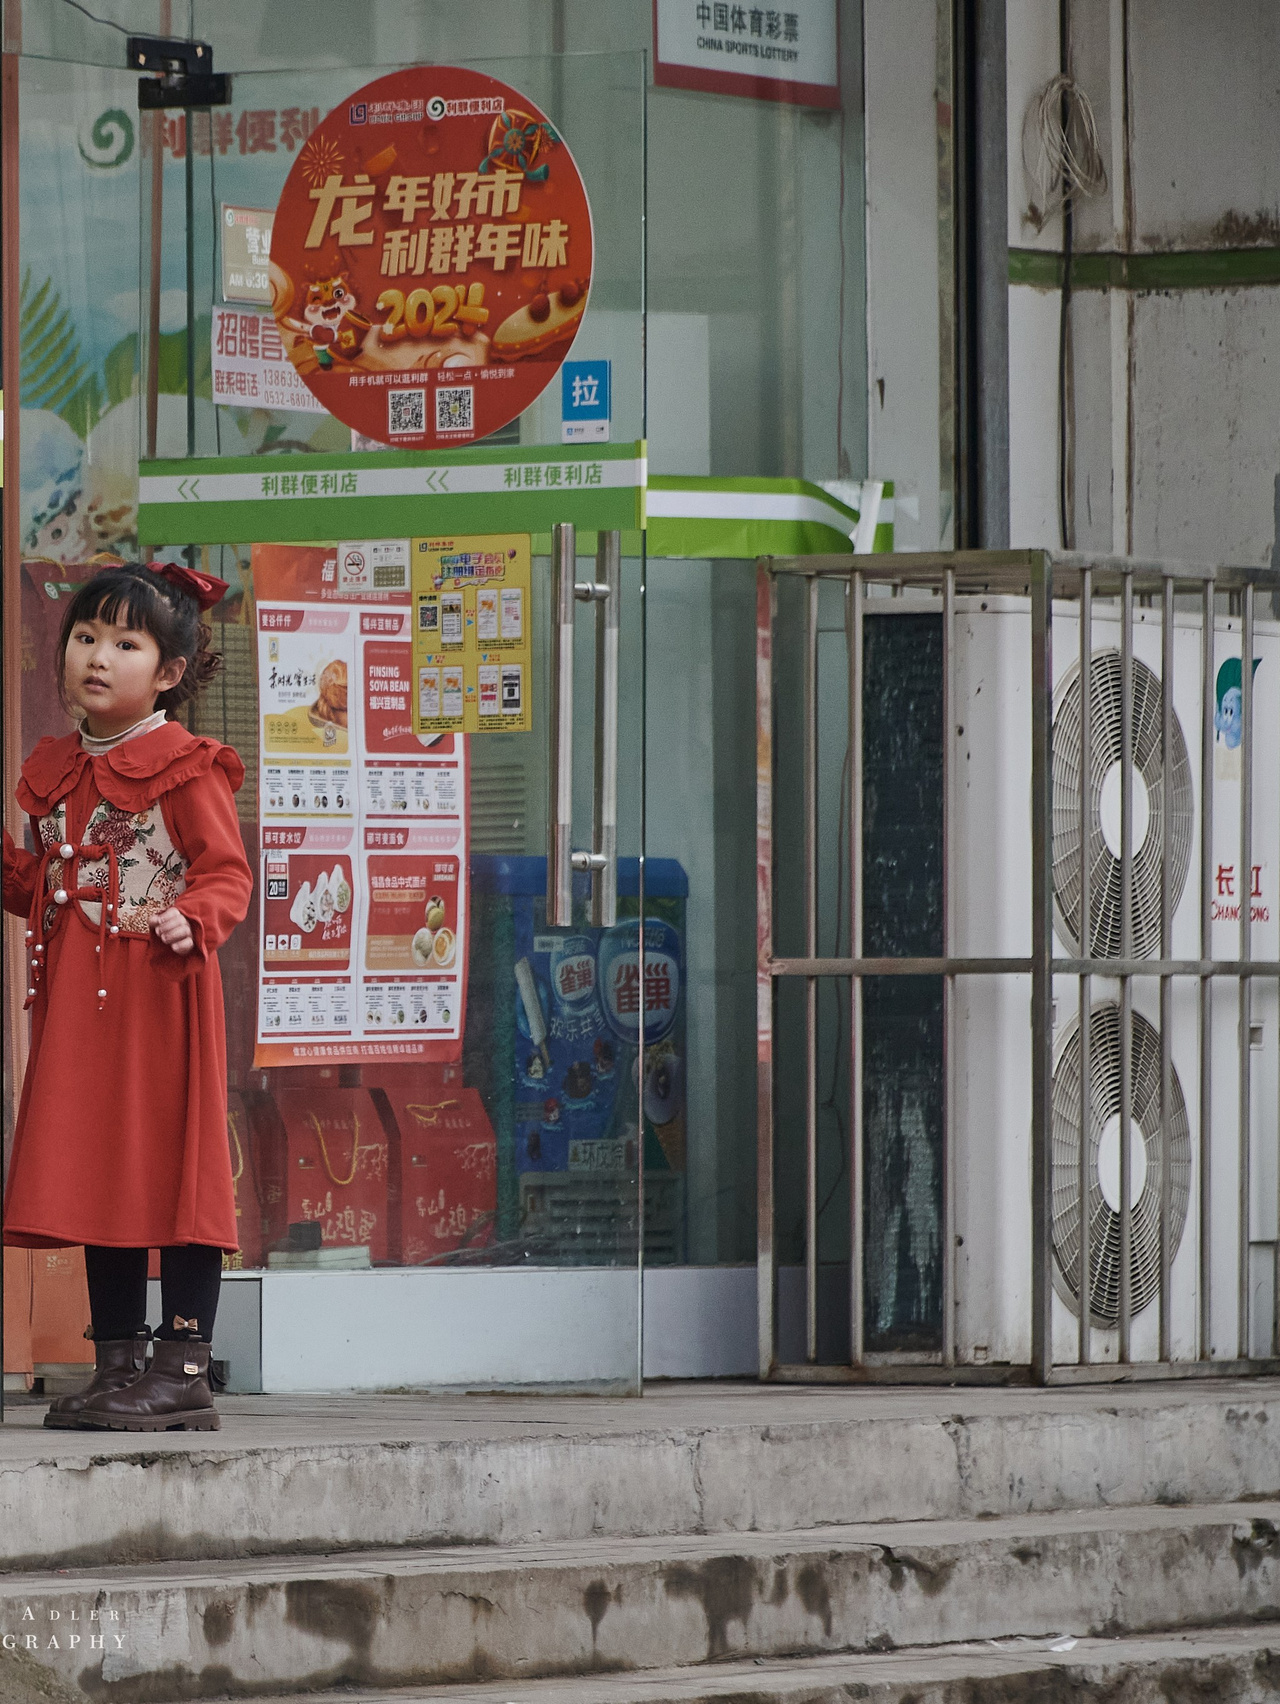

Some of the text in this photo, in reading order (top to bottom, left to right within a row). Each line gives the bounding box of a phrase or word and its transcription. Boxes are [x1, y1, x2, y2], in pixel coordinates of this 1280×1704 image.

[696, 0, 799, 43] 中国体育彩票
[696, 36, 799, 62] CHINA SPORTS LOTTERY
[142, 107, 332, 158] 利群便利
[380, 219, 568, 277] 利群年味
[376, 282, 489, 341] 2024
[572, 375, 599, 407] 拉
[261, 463, 602, 495] 利群便利店 利群便利店
[369, 666, 400, 678] FINSING
[369, 680, 410, 692] SOYA BEAN
[269, 881, 278, 896] 20
[559, 959, 594, 995] 雀巢
[613, 962, 670, 1014] 雀巢
